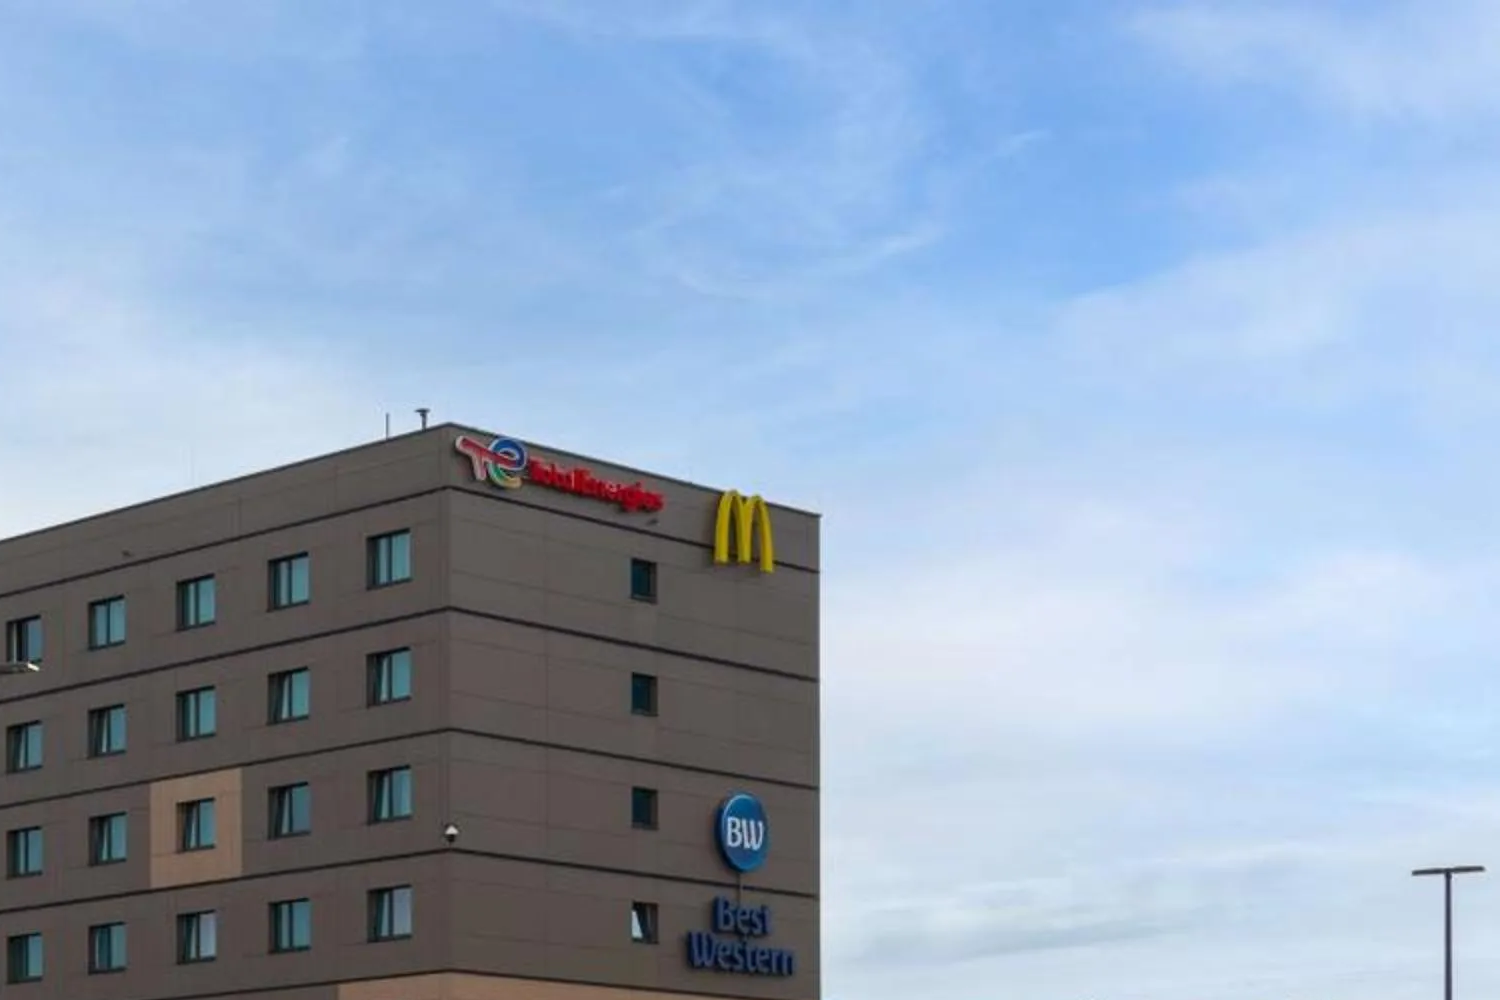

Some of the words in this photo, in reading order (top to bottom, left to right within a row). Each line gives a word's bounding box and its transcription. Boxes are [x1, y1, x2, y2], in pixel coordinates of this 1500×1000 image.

[726, 815, 765, 851] BW
[713, 897, 771, 936] Best
[687, 929, 794, 976] Western
